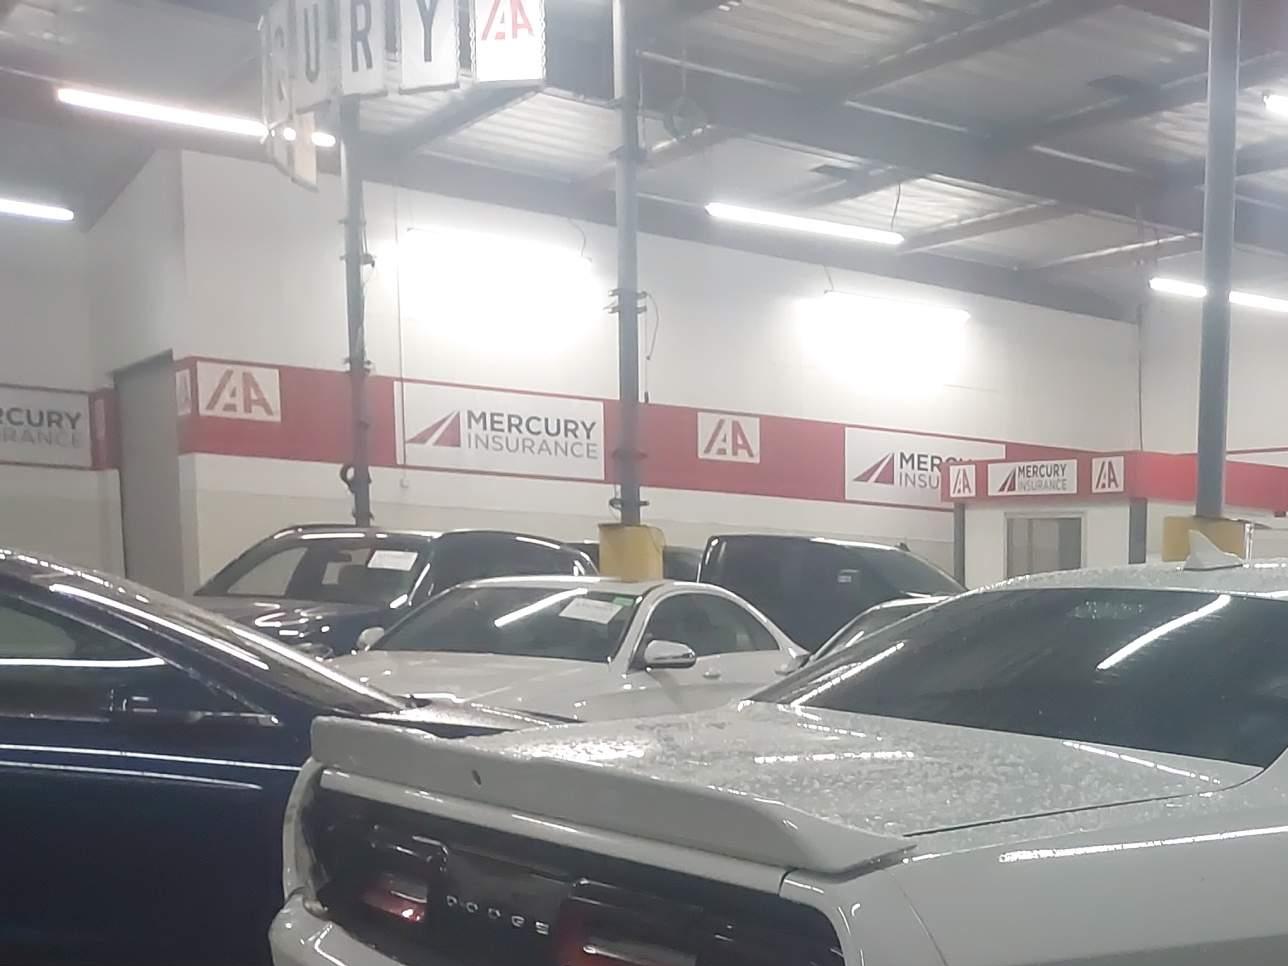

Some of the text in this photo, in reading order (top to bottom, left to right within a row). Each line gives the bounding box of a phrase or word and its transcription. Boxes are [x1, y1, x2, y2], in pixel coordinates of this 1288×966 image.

[467, 409, 597, 441] MERCURY
[466, 432, 600, 461] INSURANCE
[1017, 463, 1067, 478] MERCURY
[1017, 478, 1067, 491] INSURANCE
[446, 894, 550, 936] DODGE
